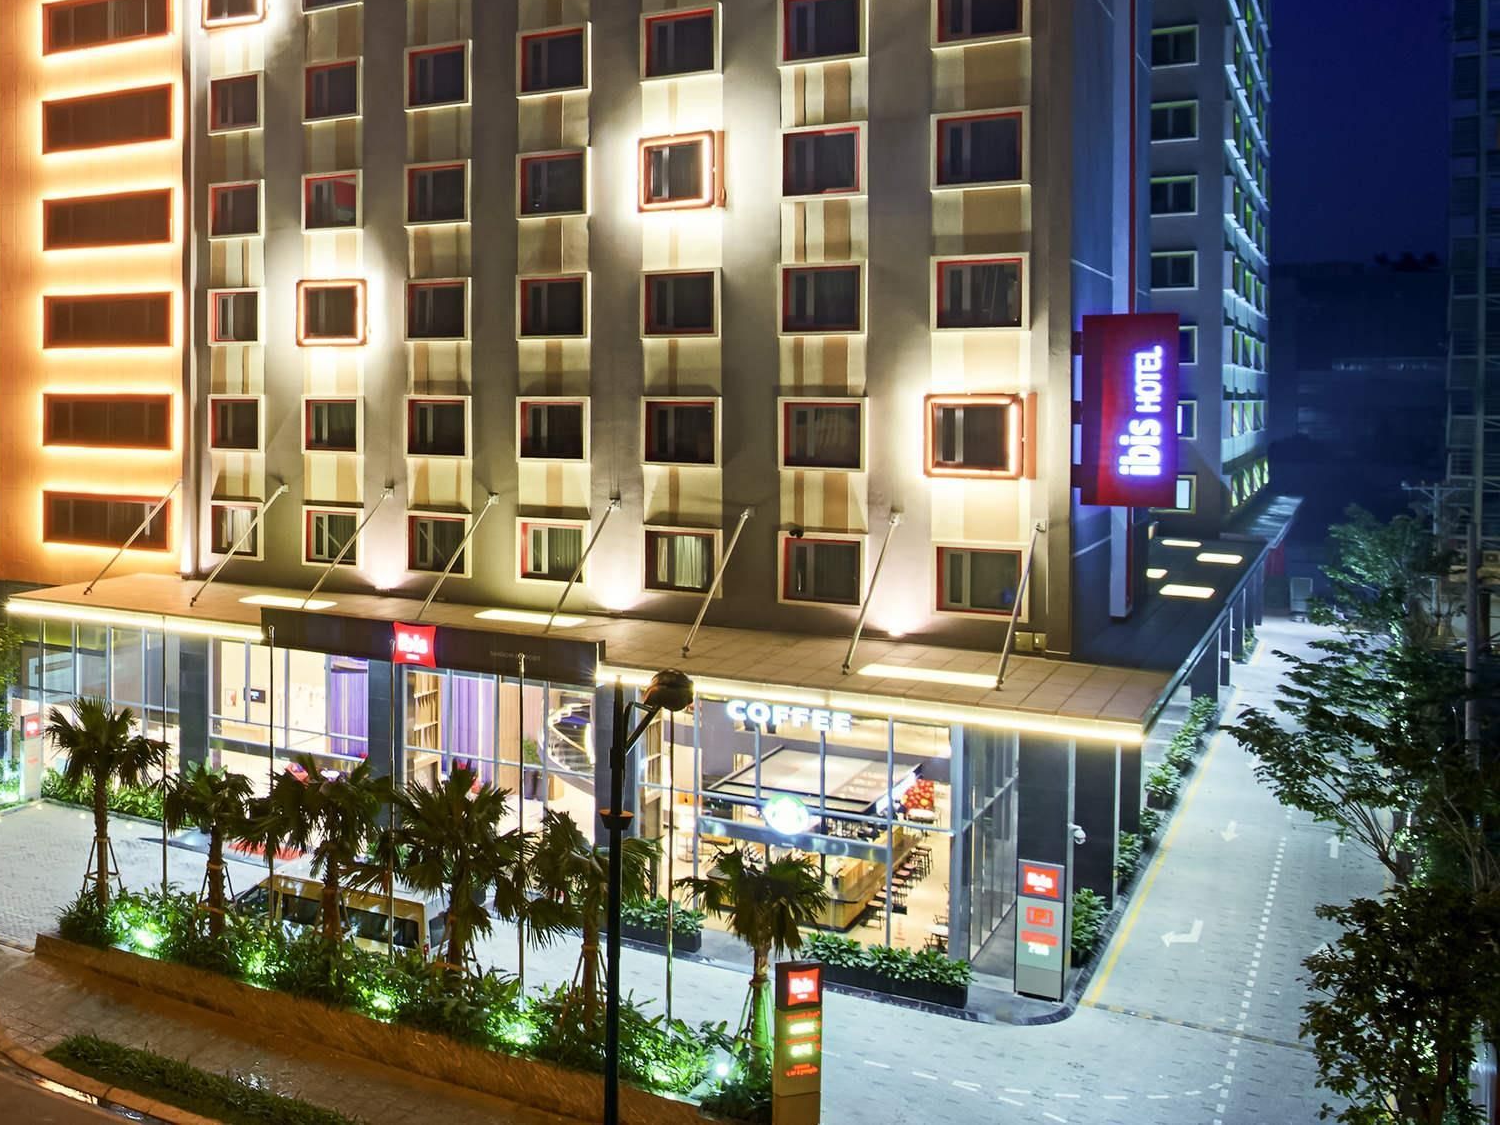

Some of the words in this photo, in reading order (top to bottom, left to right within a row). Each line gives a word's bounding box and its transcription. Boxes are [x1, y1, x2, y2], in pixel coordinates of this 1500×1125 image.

[1134, 345, 1163, 413] HOTEL
[1118, 418, 1162, 476] ibis
[726, 699, 853, 732] COFFEE
